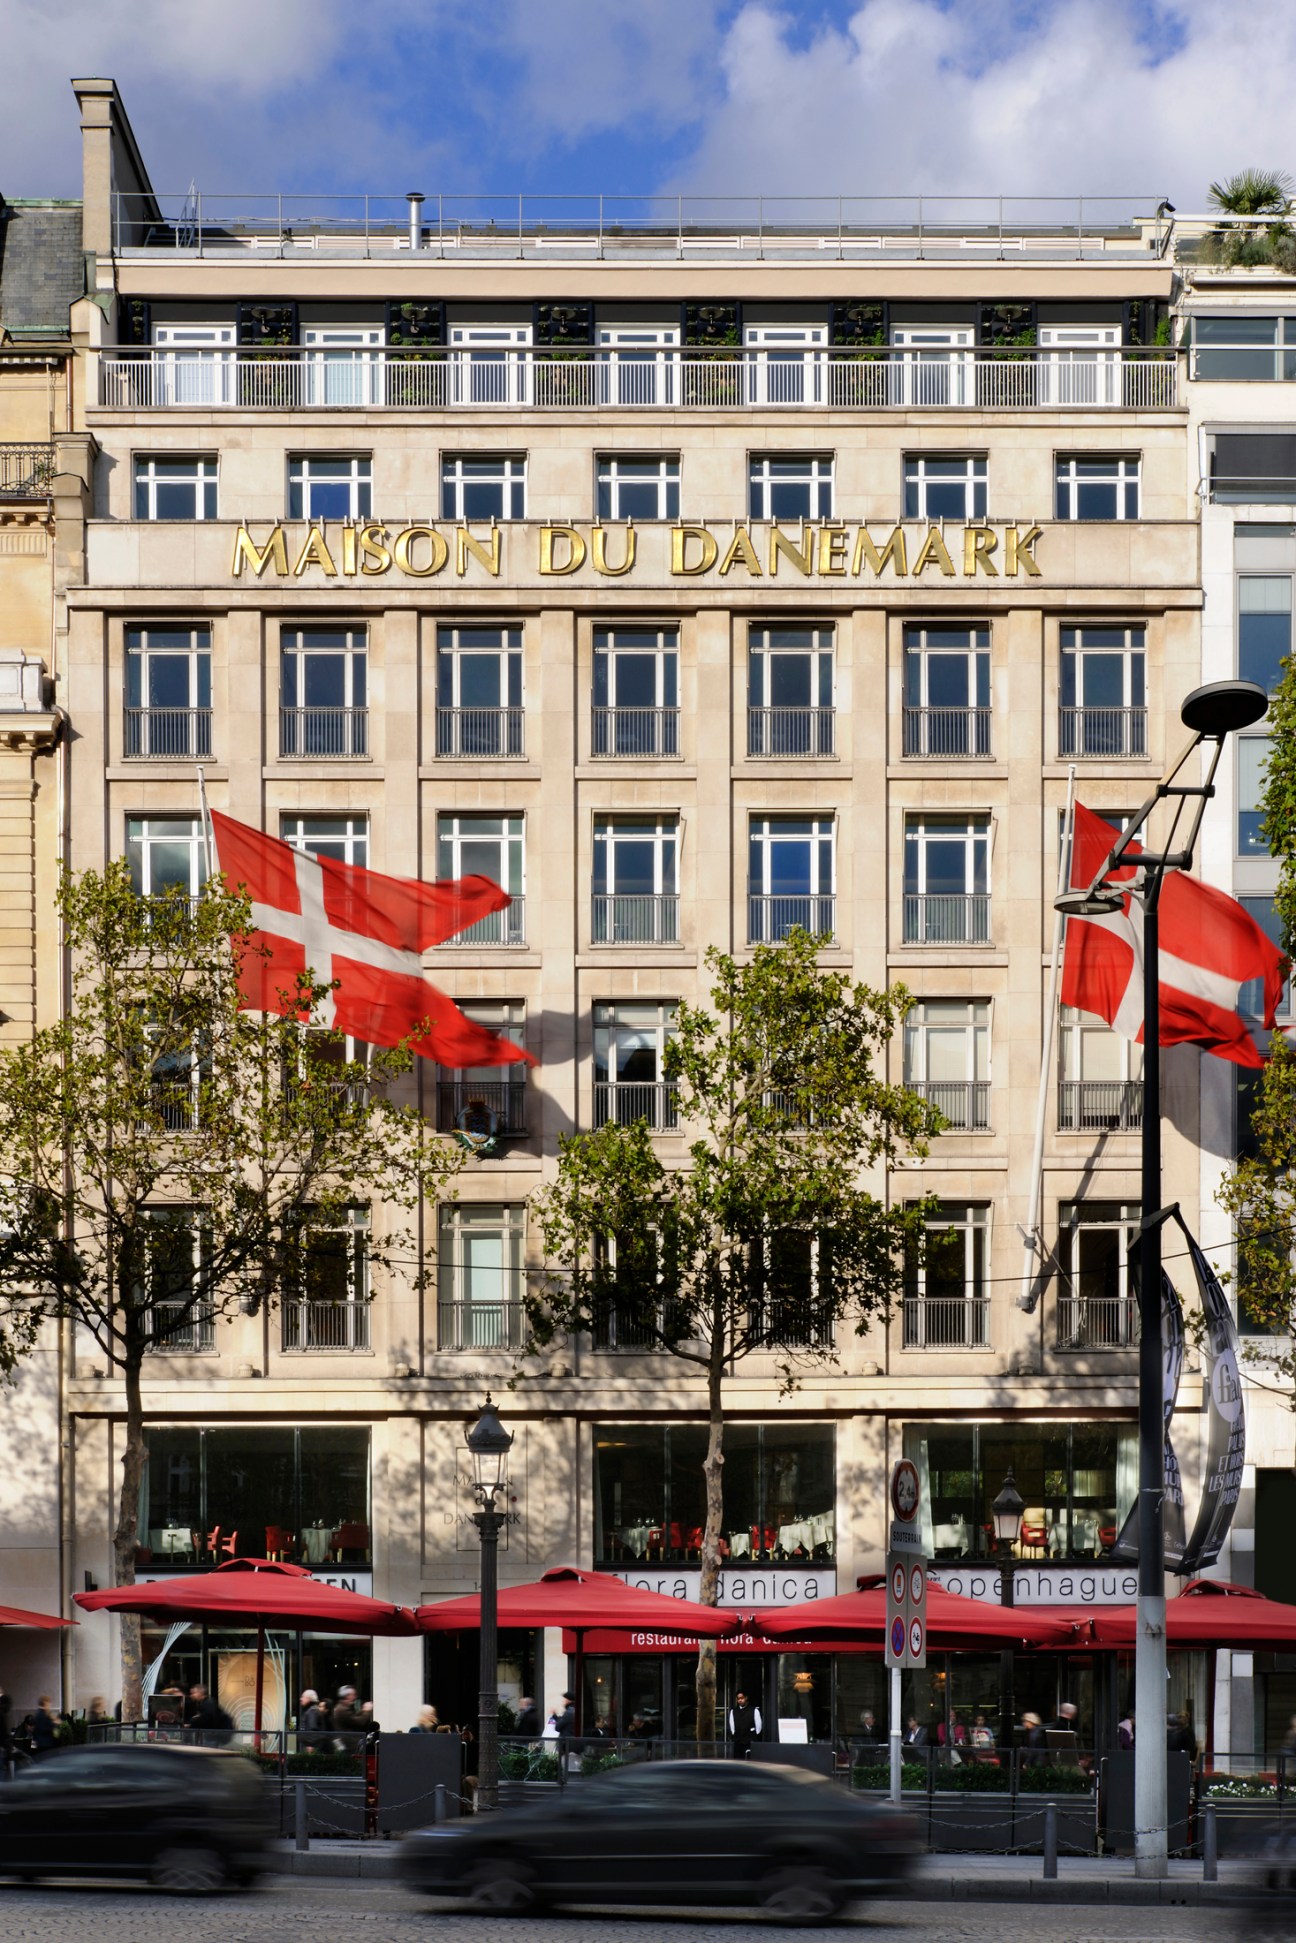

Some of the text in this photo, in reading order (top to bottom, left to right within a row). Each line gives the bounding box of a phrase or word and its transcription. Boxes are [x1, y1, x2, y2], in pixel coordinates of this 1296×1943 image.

[232, 525, 1043, 577] MAISON DU DANEMARK
[1218, 1454, 1230, 1472] ET
[1209, 1474, 1225, 1492] LES
[443, 1512, 521, 1525] DANRK
[893, 1531, 922, 1545] SOUTERRAIN
[612, 1573, 819, 1600] lora danica
[926, 1569, 1138, 1602] openhague
[631, 1632, 702, 1646] restauran
